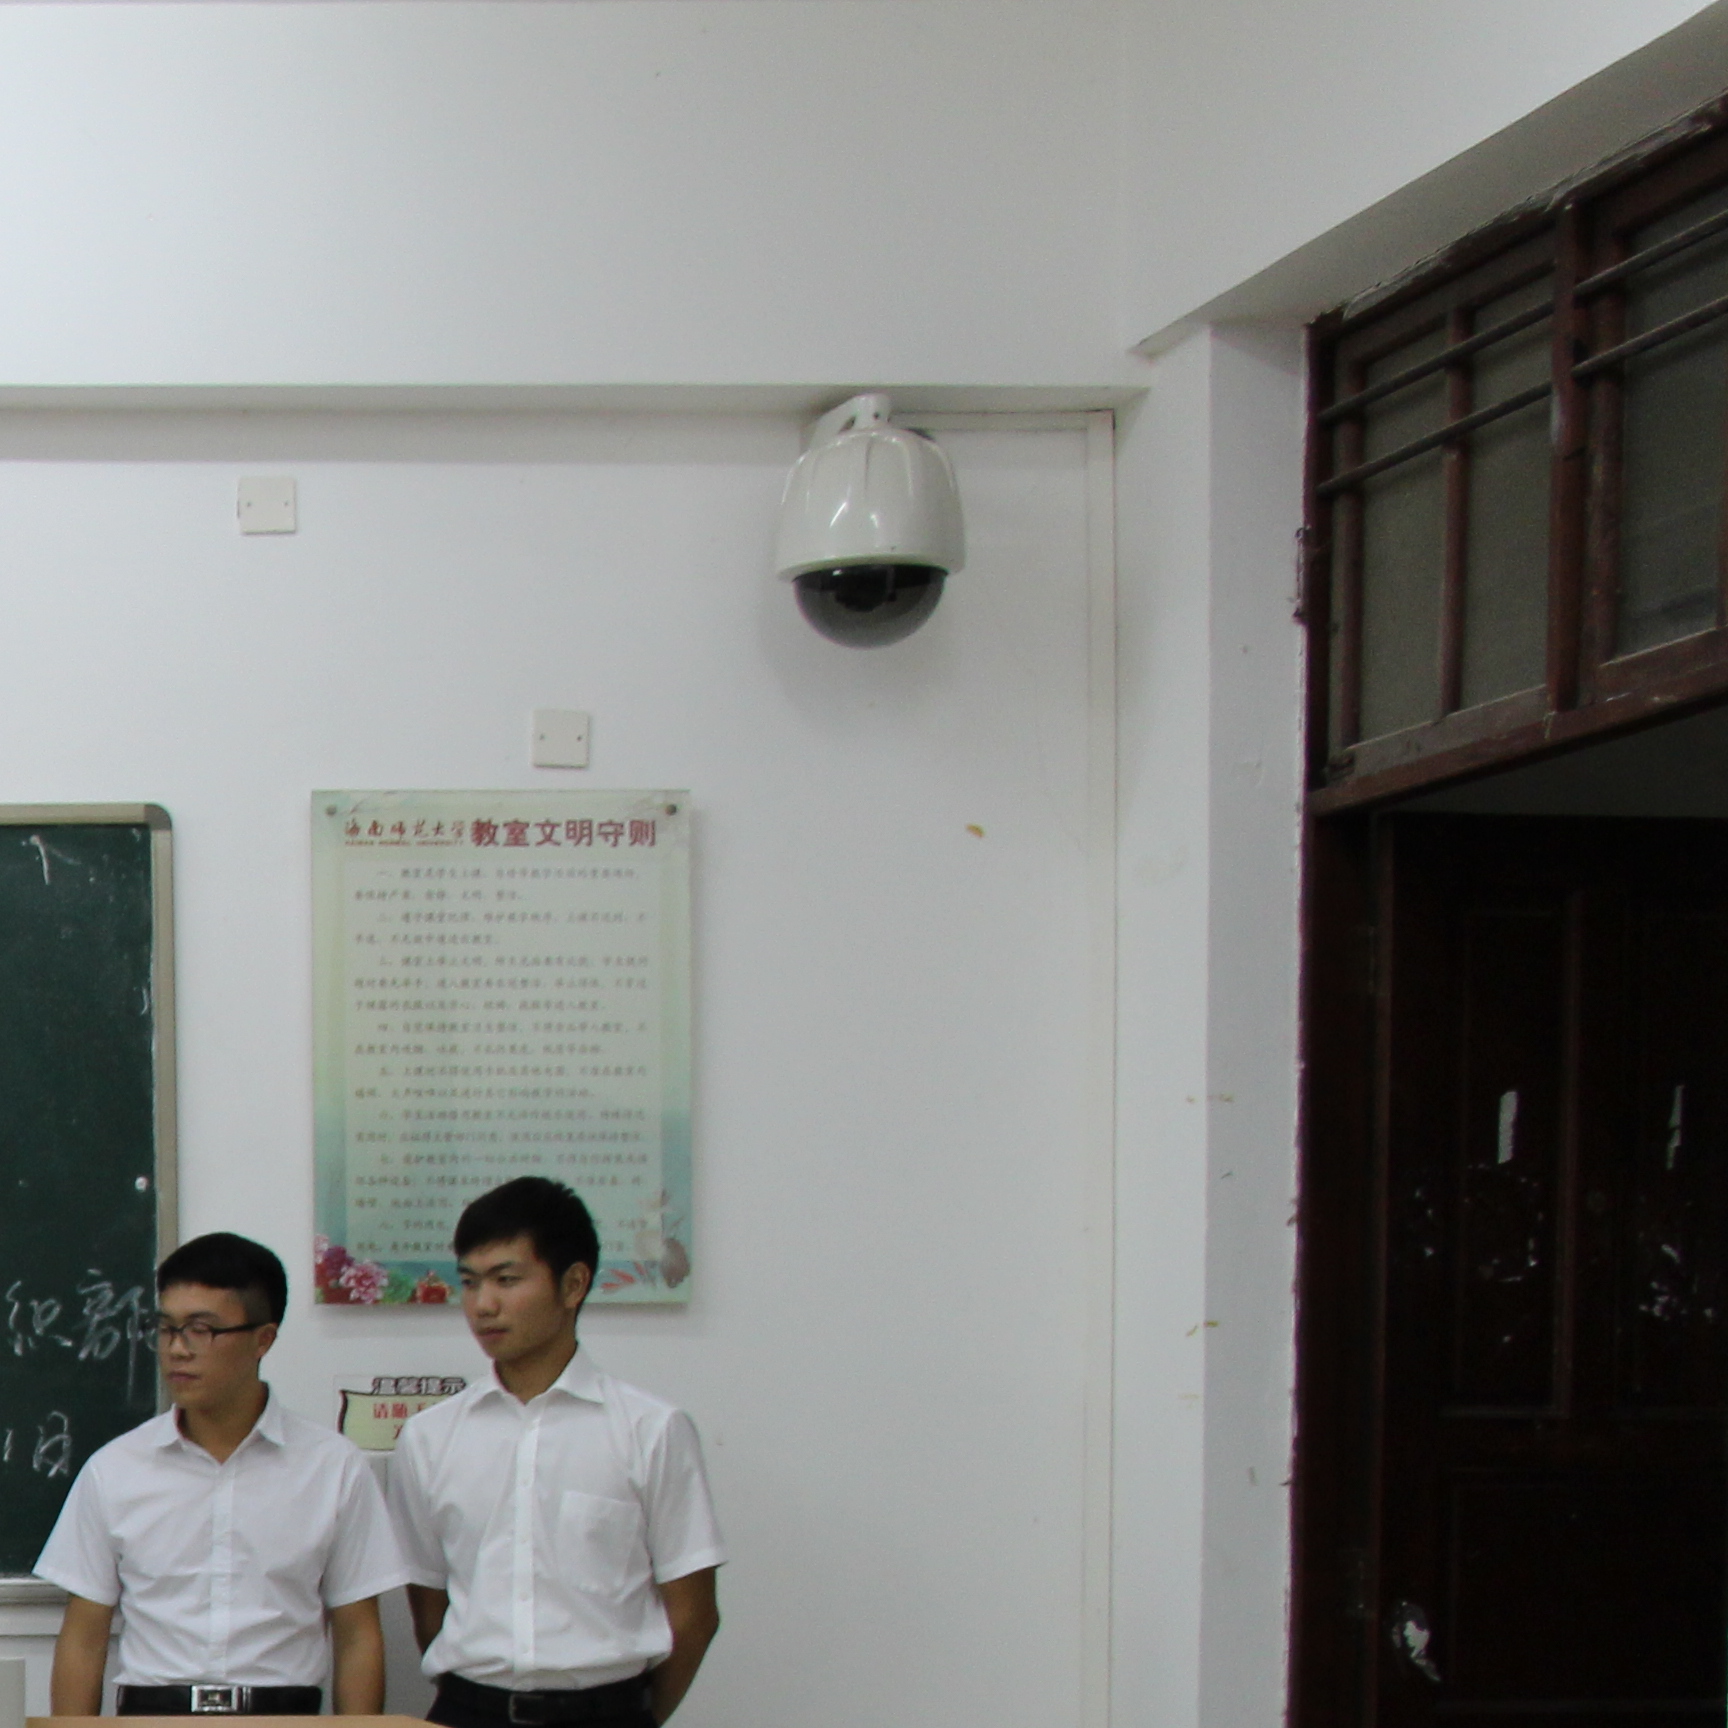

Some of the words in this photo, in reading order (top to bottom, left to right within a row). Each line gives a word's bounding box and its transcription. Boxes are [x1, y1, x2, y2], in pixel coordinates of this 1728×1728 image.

[470, 817, 657, 848] 教室文明守则
